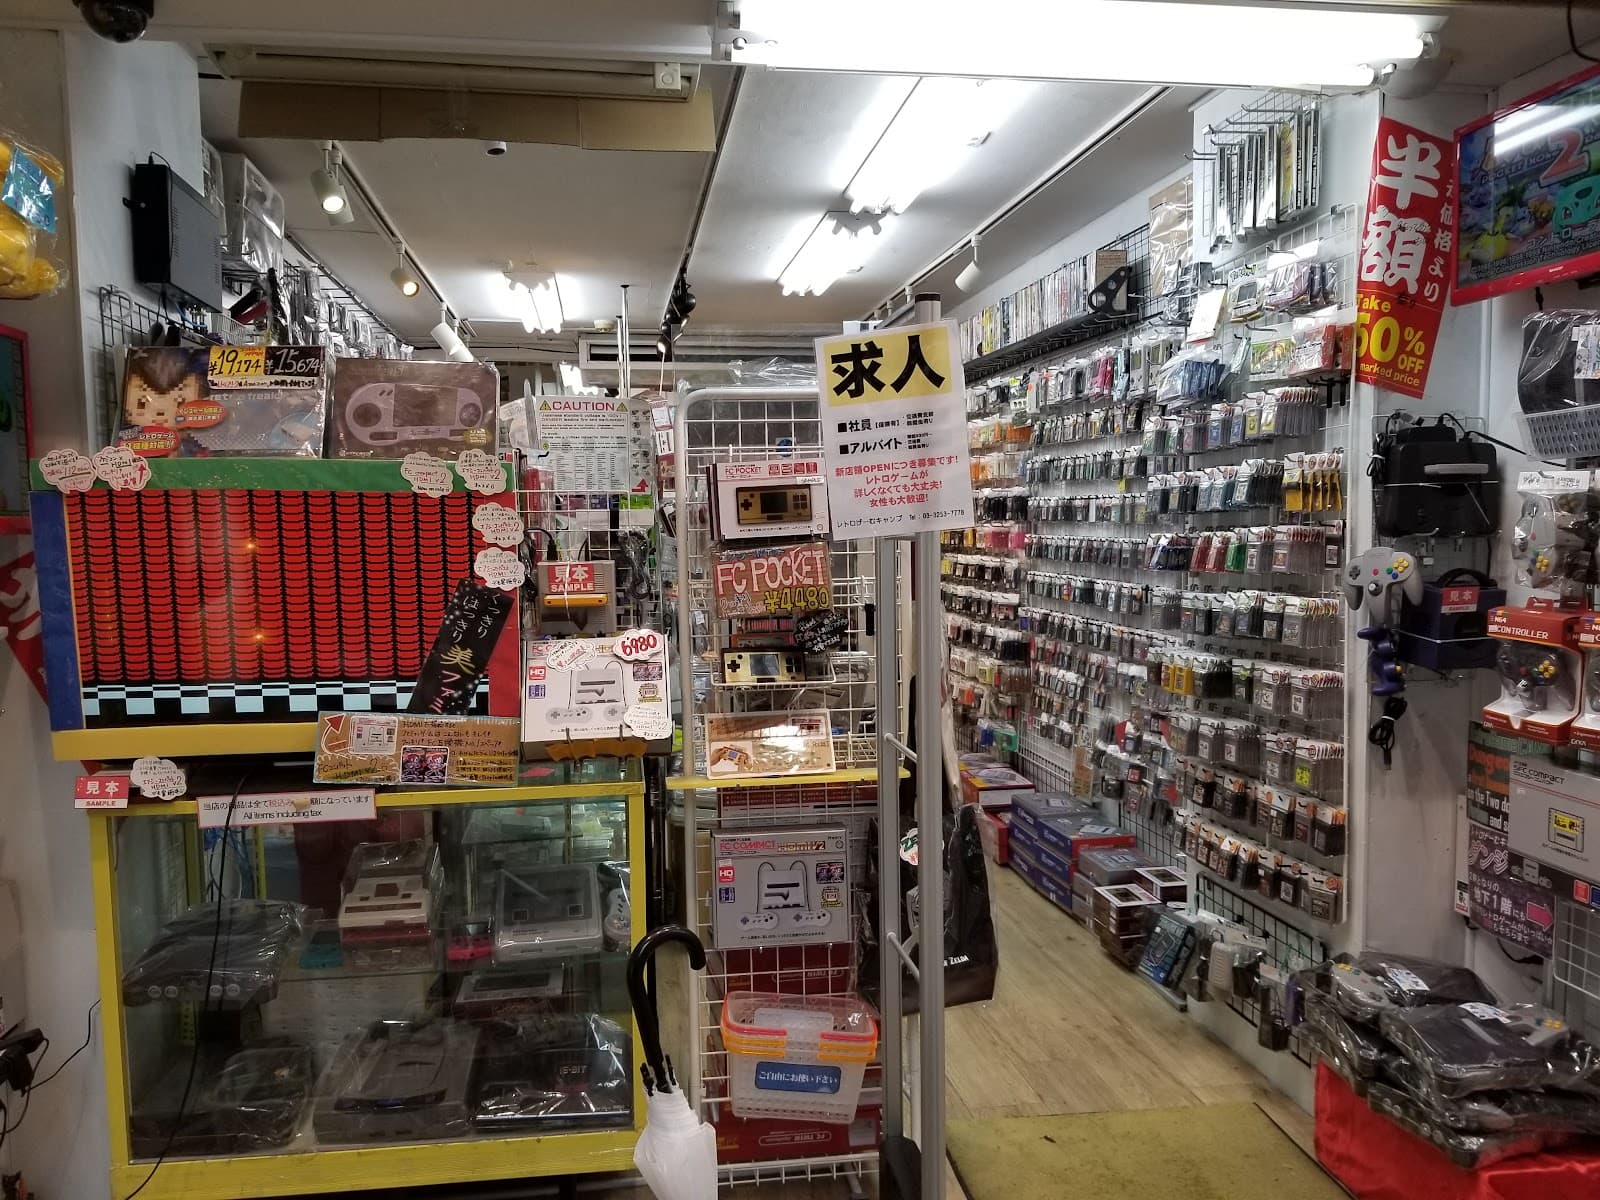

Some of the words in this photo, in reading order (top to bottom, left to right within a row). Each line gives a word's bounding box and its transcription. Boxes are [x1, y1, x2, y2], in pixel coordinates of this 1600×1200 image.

[1361, 134, 1441, 295] 半額
[1357, 294, 1391, 312] Take
[209, 350, 261, 376] ¥19,174
[265, 349, 320, 374] ¥15,674
[831, 334, 946, 399] 求人
[1398, 354, 1425, 373] OFF
[1360, 363, 1393, 378] marked
[1393, 372, 1420, 386] price
[552, 401, 615, 411] CAUTION
[849, 418, 872, 432] 社員
[850, 437, 903, 455] アルバイト
[866, 470, 928, 485] レトロゲームが
[555, 565, 589, 583] 見本
[717, 562, 747, 595] FC
[751, 548, 825, 593] POCKET
[551, 582, 594, 592] SAMPLE
[764, 586, 830, 614] ¥4480
[1497, 625, 1549, 640] CONTROLLER
[621, 634, 657, 656] 6980
[86, 780, 119, 798] 見本
[1486, 791, 1500, 811] Two
[254, 811, 275, 819] items
[276, 809, 310, 818] including
[311, 809, 322, 817] tax
[732, 840, 776, 850] COMPACT
[950, 954, 969, 965] ZELDA
[758, 1069, 838, 1085] ご自由にお使い下さい
